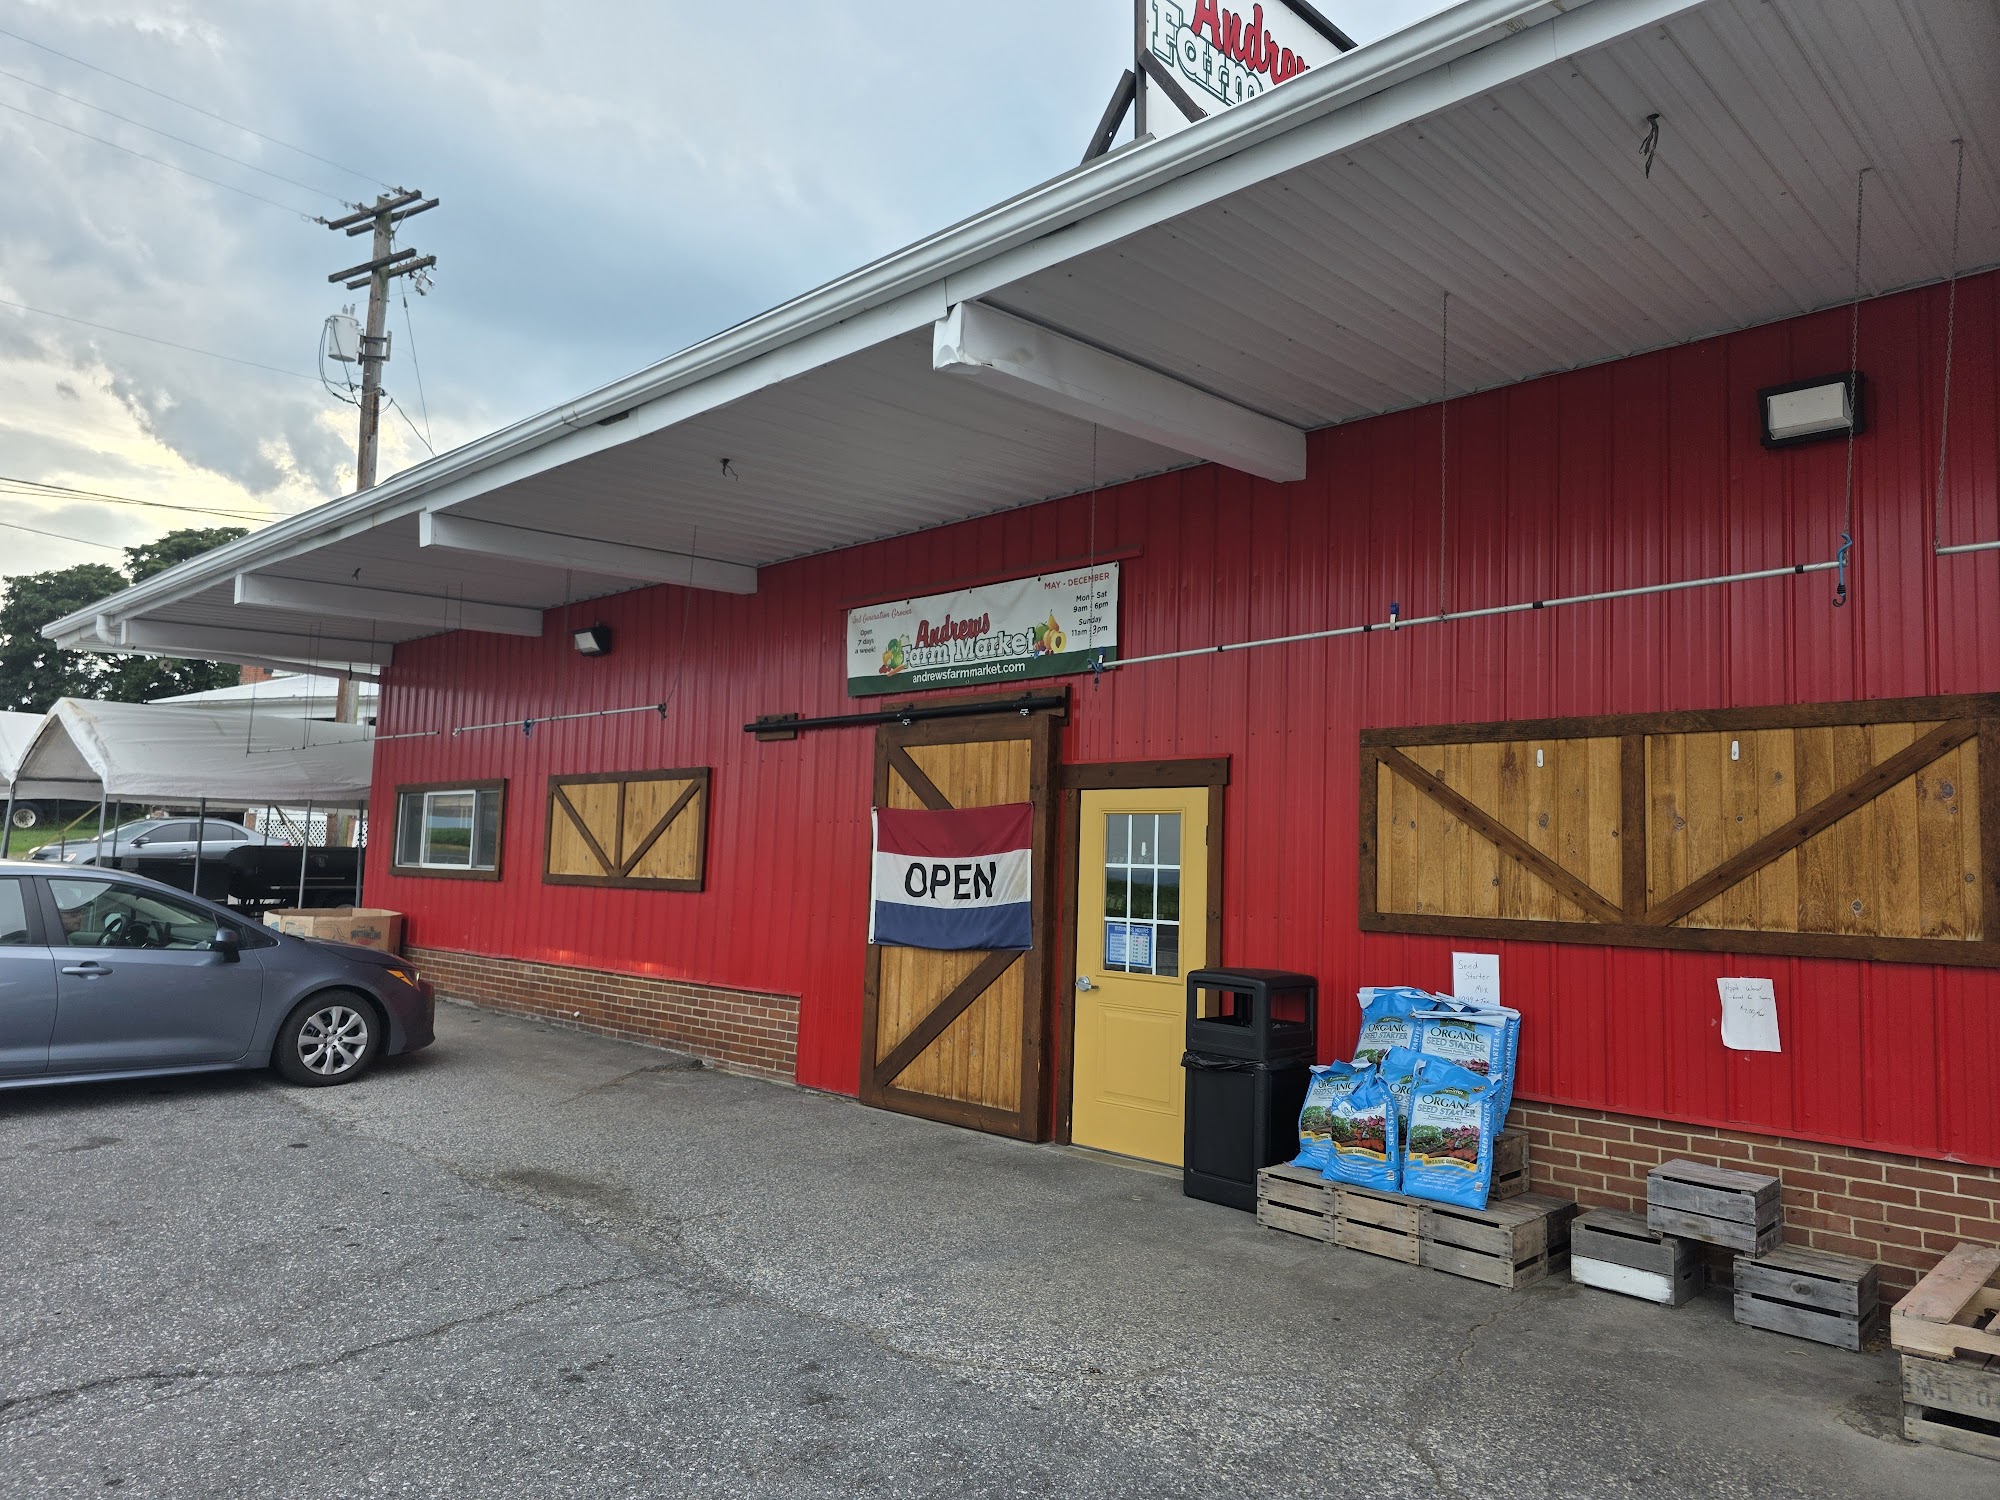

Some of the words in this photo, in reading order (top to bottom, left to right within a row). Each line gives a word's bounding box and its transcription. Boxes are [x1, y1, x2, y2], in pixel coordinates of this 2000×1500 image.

[1190, 0, 1311, 86] Andre
[1044, 580, 1061, 590] MAY
[1068, 572, 1110, 587] DECEMBER
[1076, 594, 1090, 602] Mon
[1096, 590, 1108, 599] Sat
[1073, 605, 1088, 613] 9am
[1094, 601, 1109, 610] 6pm
[1078, 616, 1103, 626] Sunday
[860, 628, 873, 637] Open
[914, 612, 991, 649] Andrews
[1071, 629, 1088, 637] 11am
[1092, 624, 1108, 635] 3pm
[862, 638, 875, 646] days
[901, 640, 950, 670] Farm
[953, 627, 1037, 662] Market
[912, 661, 1026, 684] andrewsfarmmarket.com
[904, 861, 997, 900] OPEN
[1458, 959, 1479, 970] Seed
[1475, 984, 1490, 994] Mix
[1364, 1031, 1378, 1039] SEED
[1378, 1032, 1408, 1040] STARTER
[1368, 1023, 1409, 1032] ORGANIC
[1430, 1026, 1484, 1044] ORGANIC
[1411, 1024, 1422, 1053] TARTER
[1426, 1036, 1448, 1046] SEED
[1448, 1038, 1486, 1053] STARTER
[1490, 1038, 1500, 1069] STARTER
[1417, 1103, 1438, 1114] SEED
[1439, 1108, 1476, 1118] STARTER
[1483, 1104, 1491, 1136] STARTER
[1480, 1137, 1489, 1158] SEED
